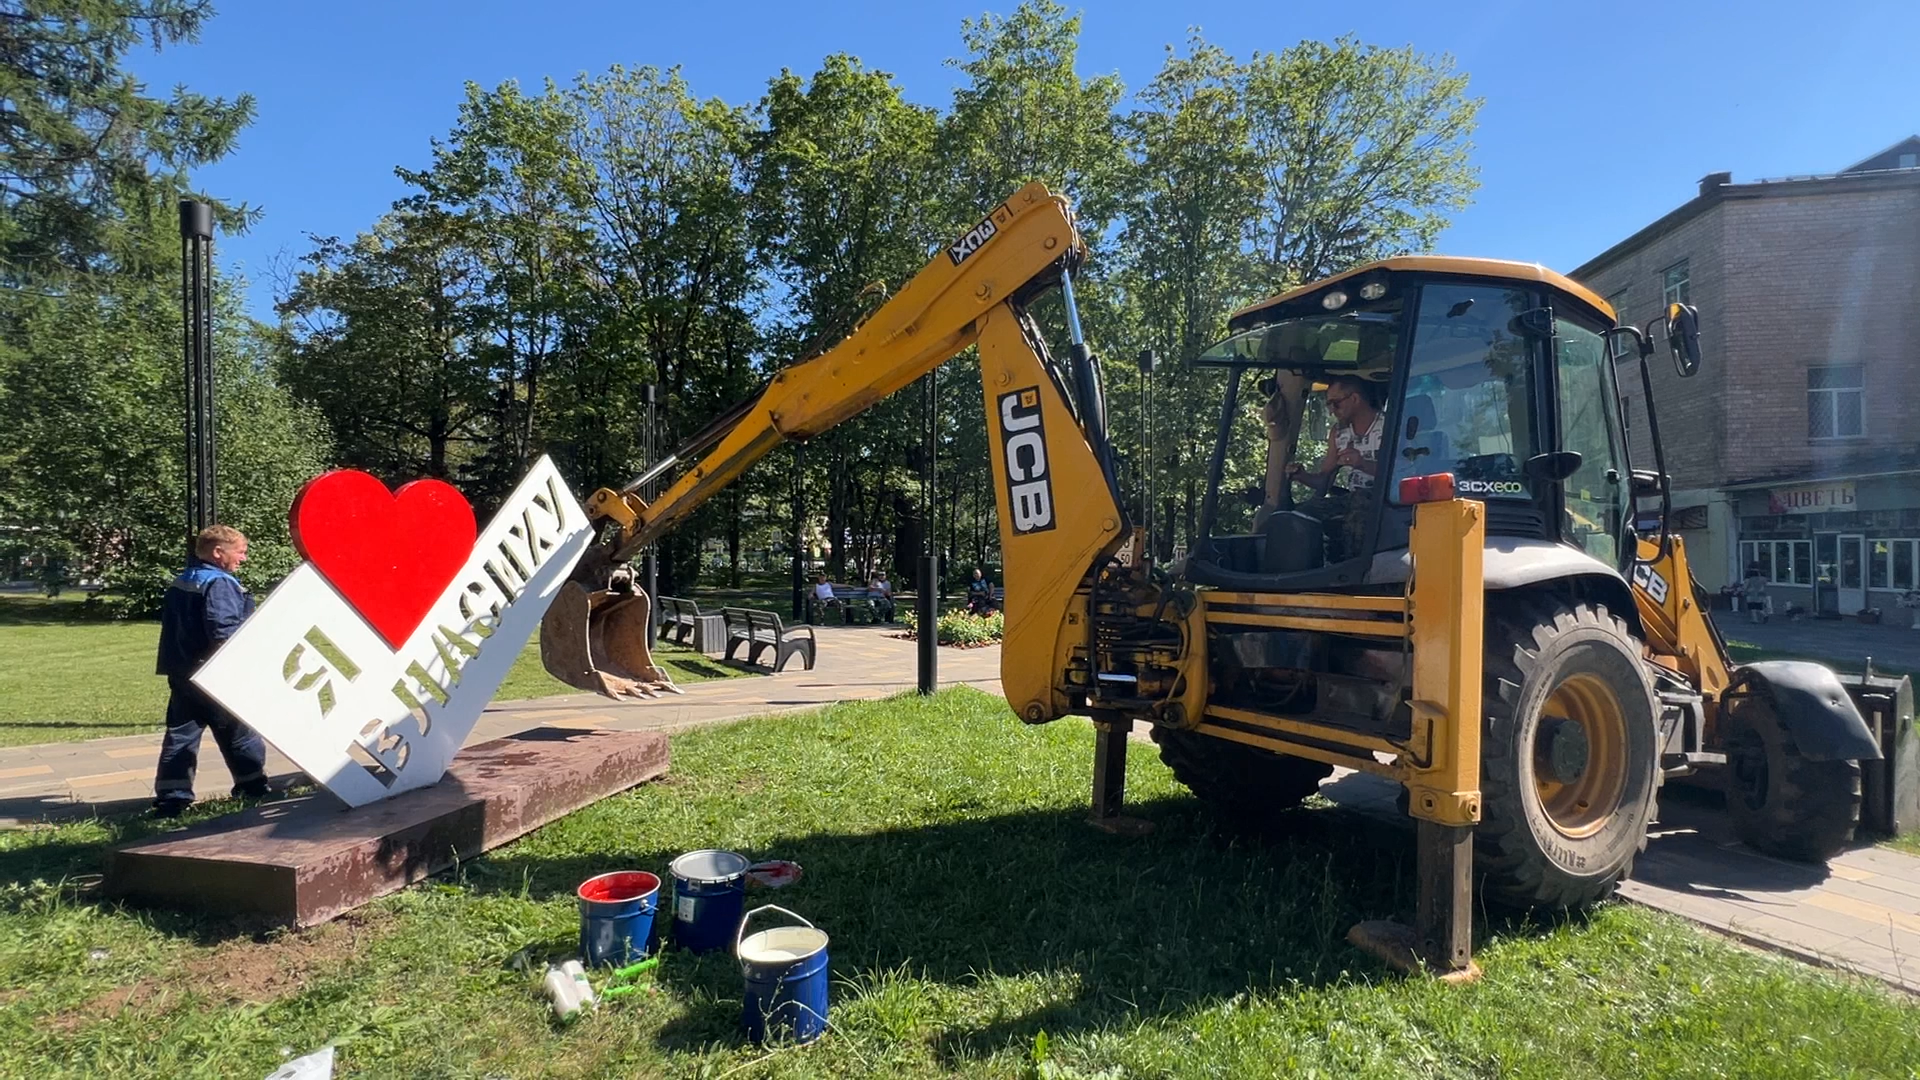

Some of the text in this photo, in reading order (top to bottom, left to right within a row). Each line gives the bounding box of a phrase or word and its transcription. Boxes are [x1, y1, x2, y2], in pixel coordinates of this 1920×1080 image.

[951, 219, 997, 263] 3CX
[1001, 395, 1052, 532] JCB
[1633, 564, 1668, 603] CB
[282, 625, 362, 719] Я
[345, 475, 567, 789] ВЛАСИХУ
